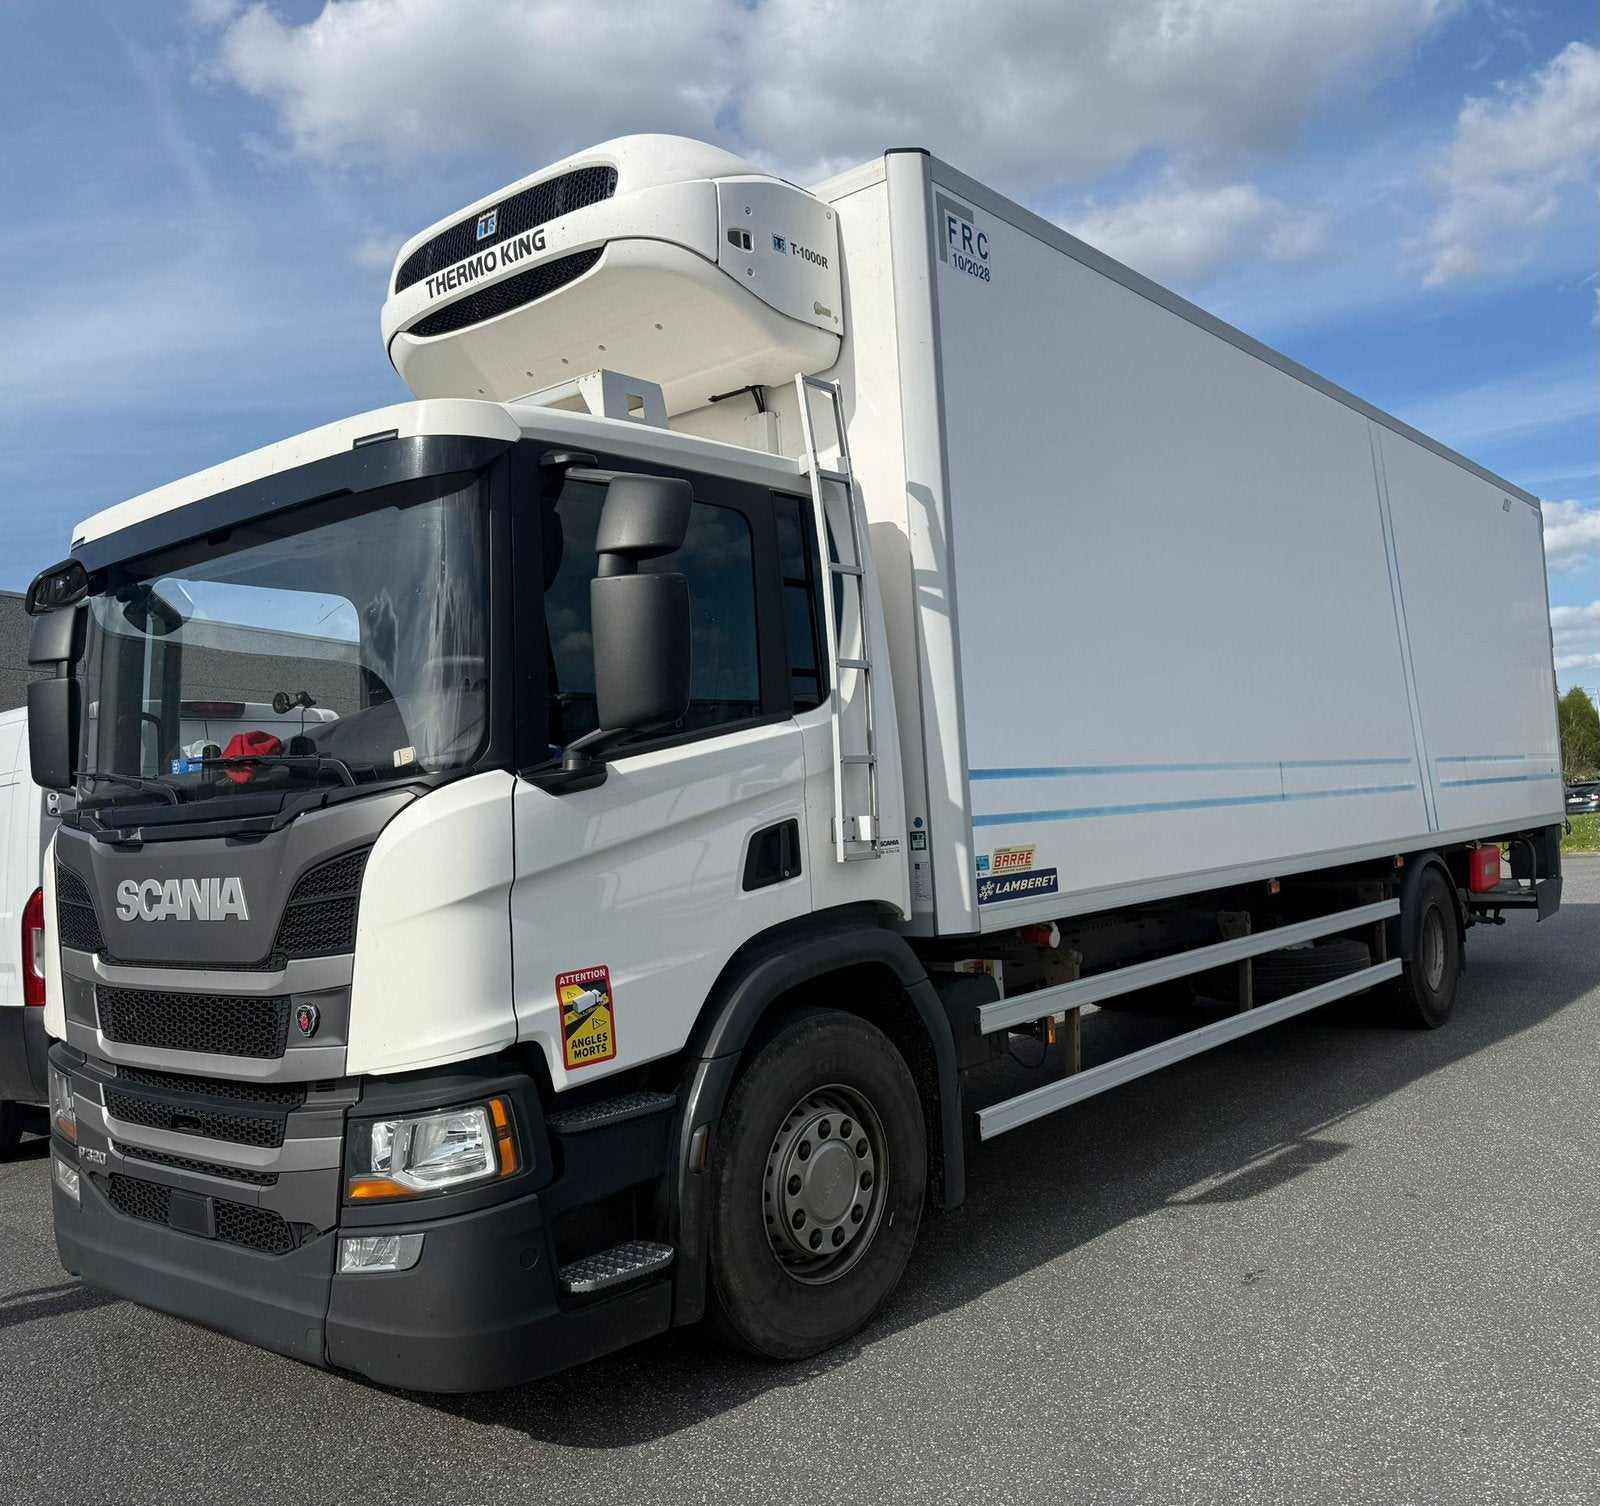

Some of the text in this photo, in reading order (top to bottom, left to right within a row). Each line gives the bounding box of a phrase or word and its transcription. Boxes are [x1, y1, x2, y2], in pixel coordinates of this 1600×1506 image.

[947, 215, 988, 260] FRC
[425, 228, 547, 299] THERMO KING
[789, 242, 829, 270] T-1000R
[952, 252, 991, 283] 10/2028
[994, 851, 1033, 868] BARRE
[995, 874, 1057, 894] LAMBERET
[116, 877, 249, 921] SCANIA
[559, 968, 606, 985] ATTENTION
[571, 1032, 608, 1050] ANGLES
[574, 1043, 607, 1060] MORTS
[78, 1145, 107, 1165] P320
